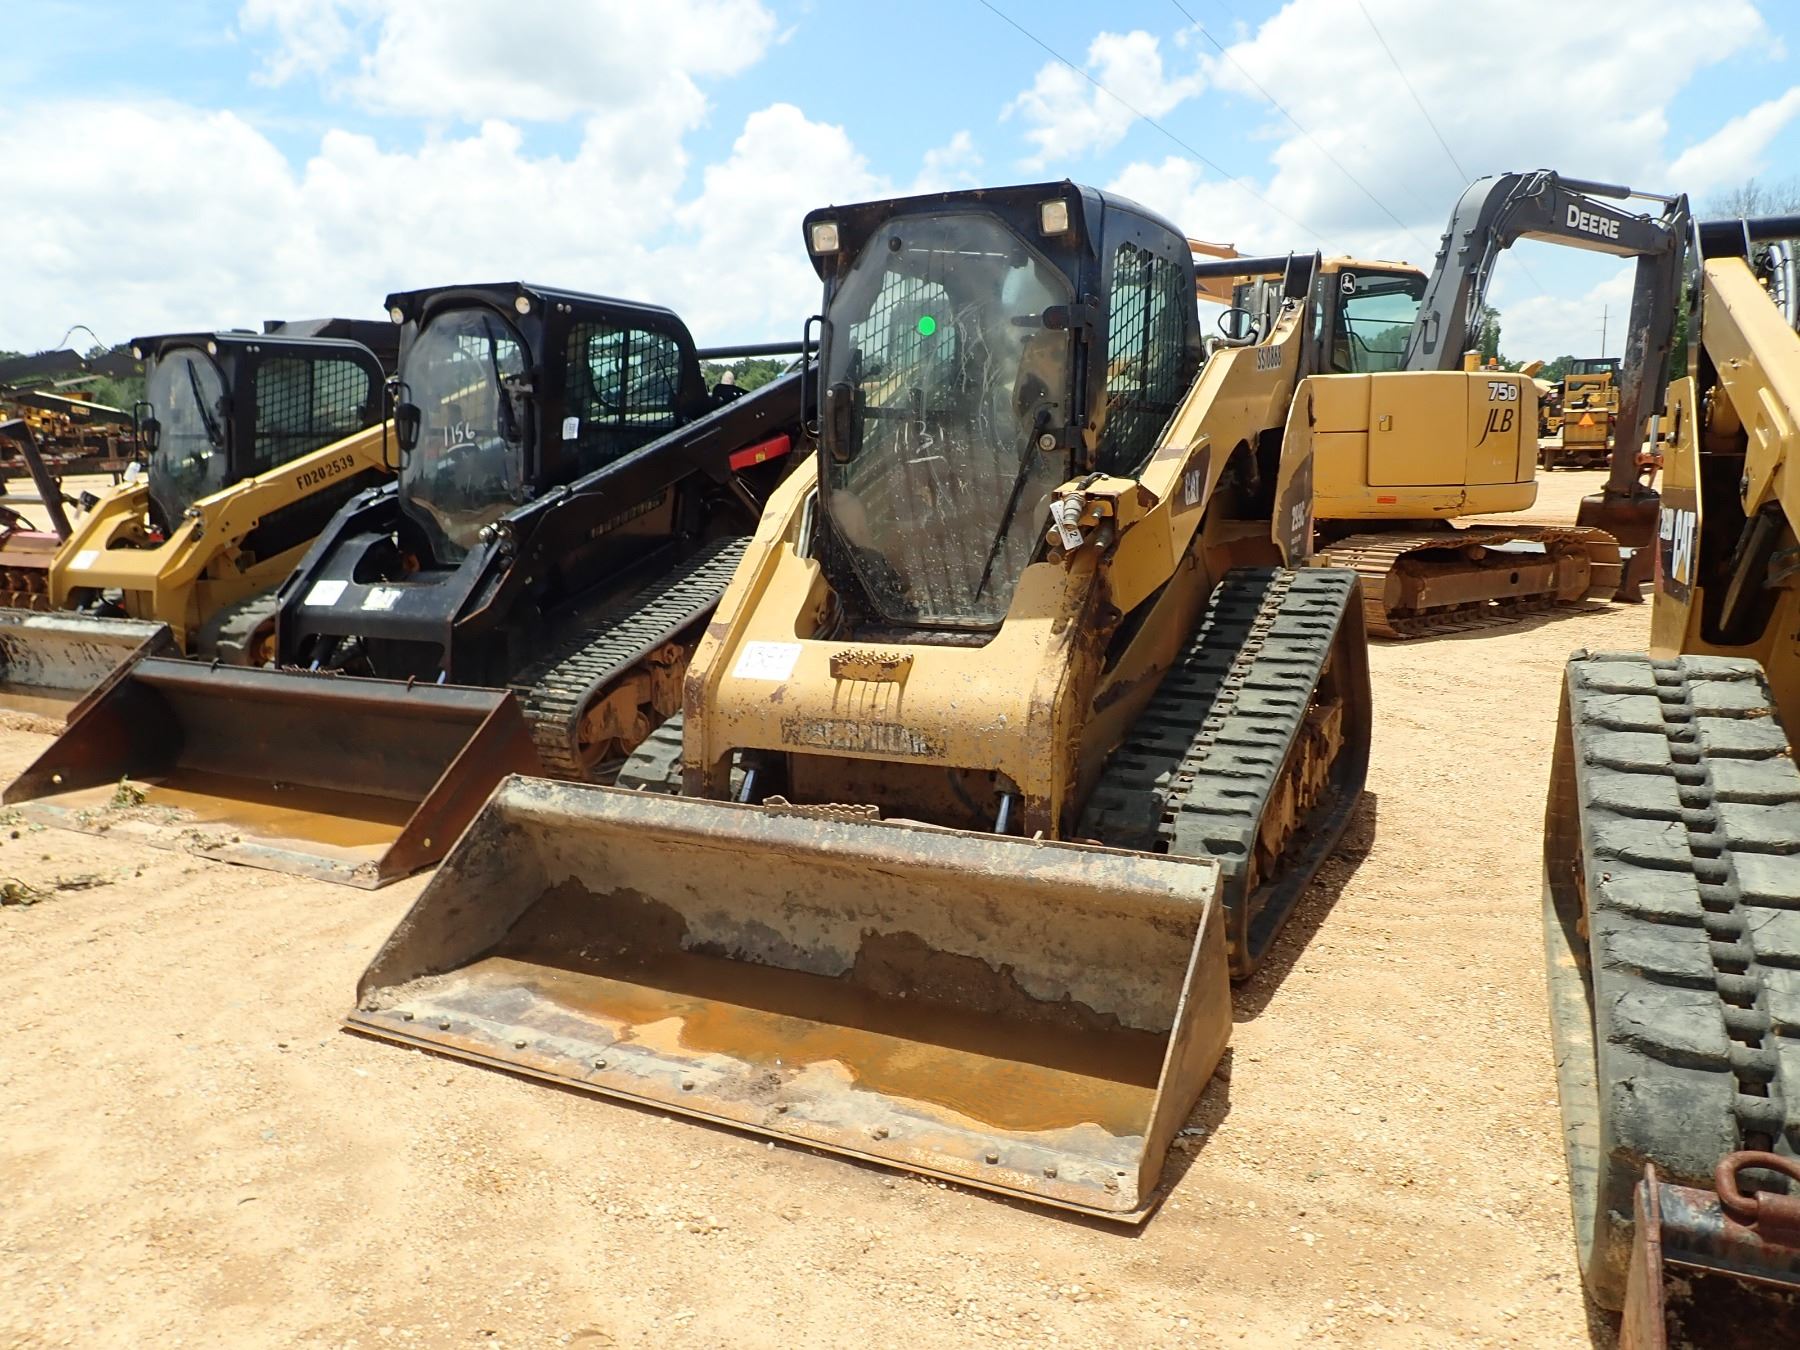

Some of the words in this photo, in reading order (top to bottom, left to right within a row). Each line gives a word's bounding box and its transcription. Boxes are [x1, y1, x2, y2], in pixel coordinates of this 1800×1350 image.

[1566, 204, 1620, 239] DEERE
[1487, 381, 1518, 401] 75D
[444, 420, 476, 447] 1156
[1474, 408, 1514, 448] JLB
[296, 454, 355, 490] FD202539
[1184, 470, 1200, 506] CAT
[1672, 508, 1696, 586] CAT
